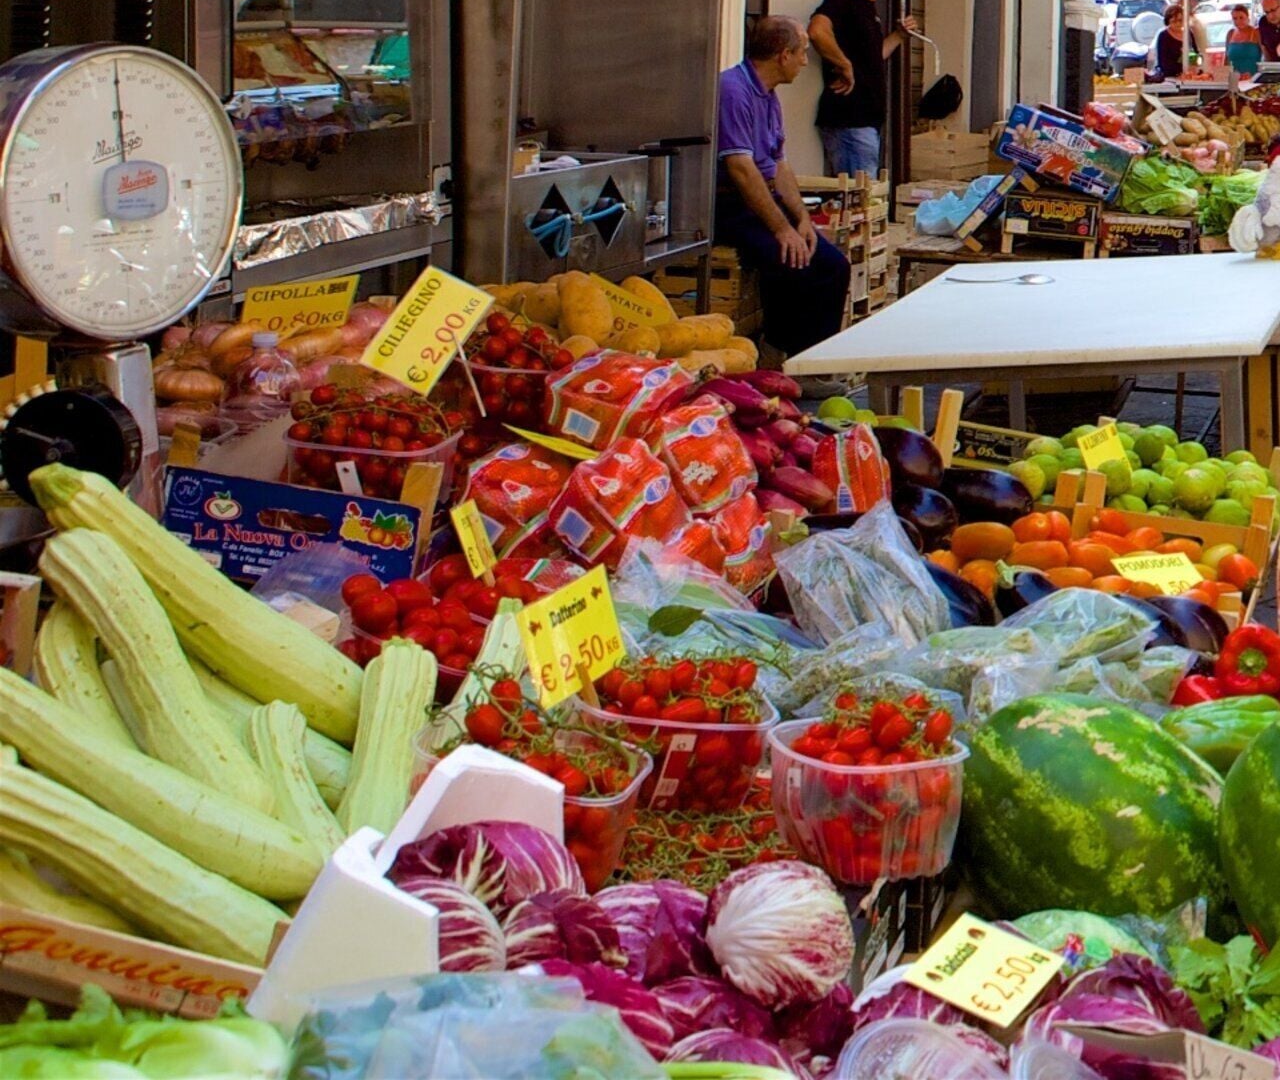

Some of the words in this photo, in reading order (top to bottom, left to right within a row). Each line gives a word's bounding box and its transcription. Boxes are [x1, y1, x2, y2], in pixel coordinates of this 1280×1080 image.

[251, 284, 329, 303] CIPOLLA
[378, 277, 442, 358] CILIEGINO
[421, 311, 465, 366] 2,00
[462, 297, 480, 317] KG
[194, 523, 218, 541] La
[224, 522, 285, 548] Nuova
[1118, 556, 1185, 573] POMODORI
[991, 956, 1036, 1000] 2,50
